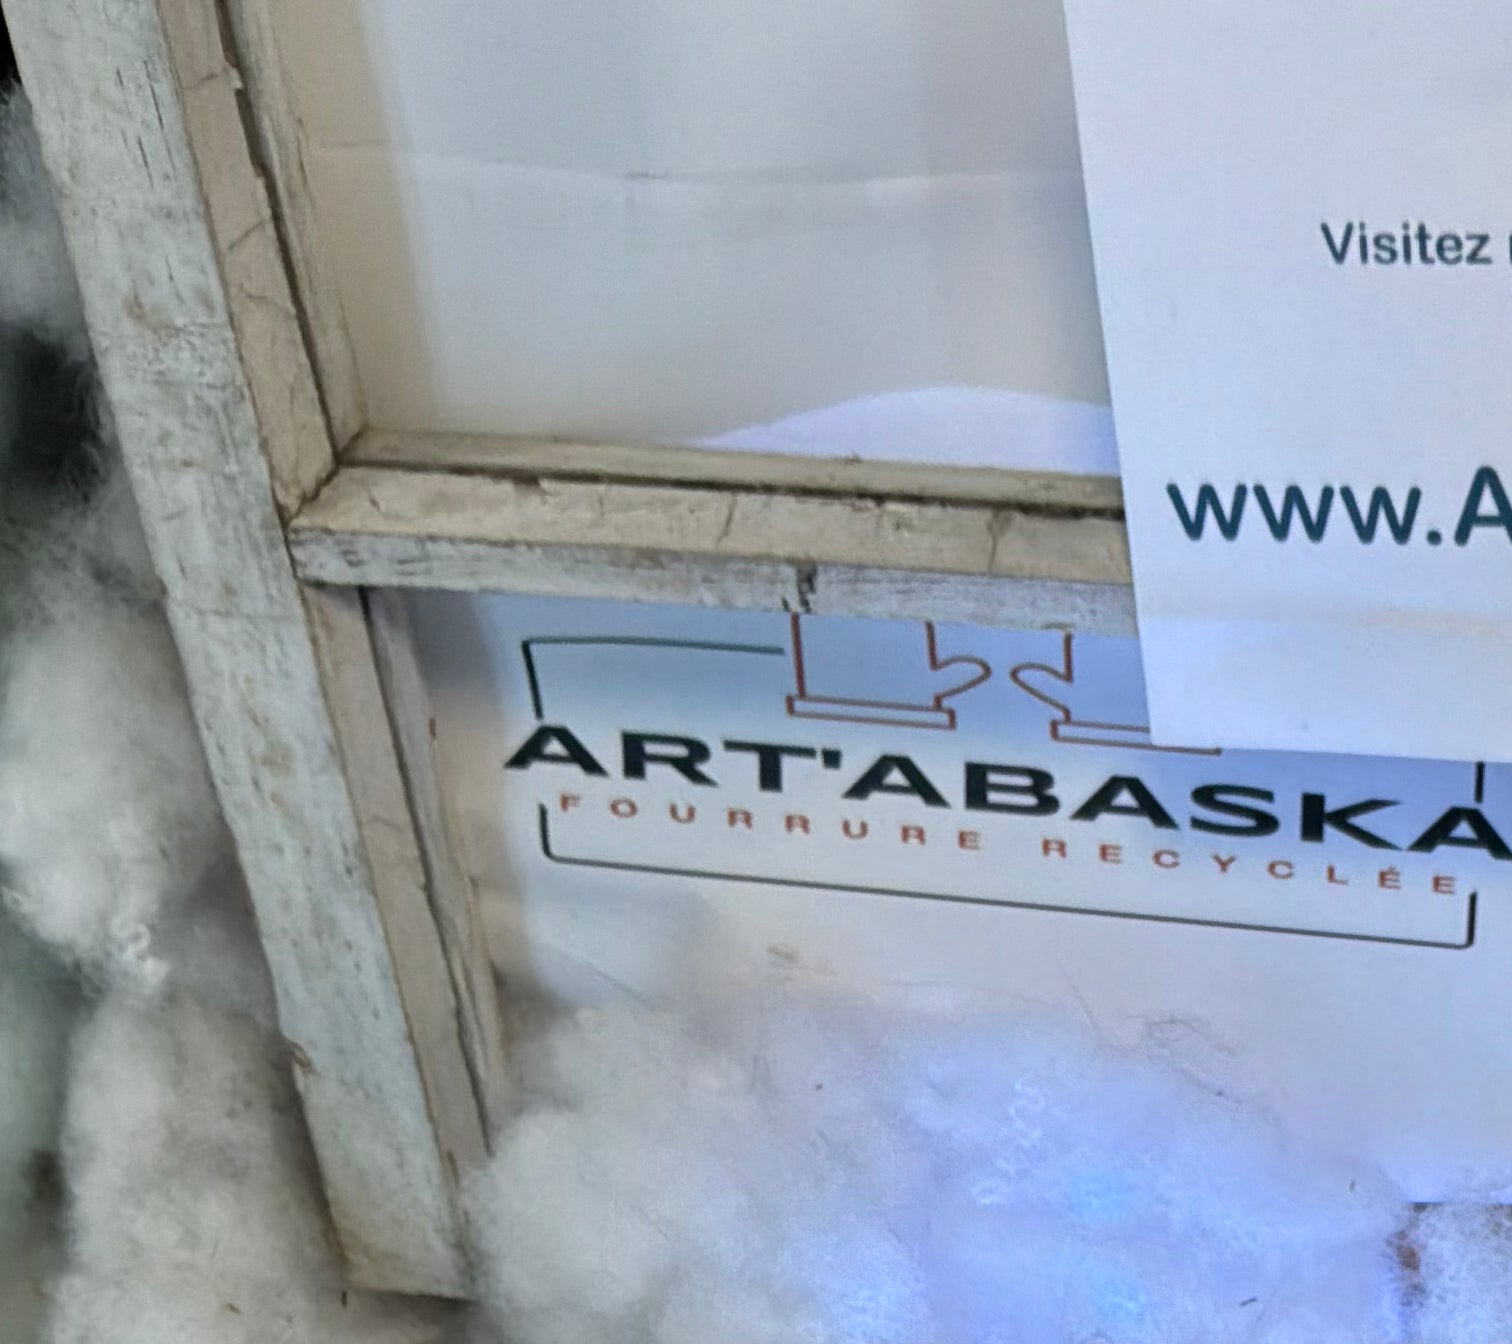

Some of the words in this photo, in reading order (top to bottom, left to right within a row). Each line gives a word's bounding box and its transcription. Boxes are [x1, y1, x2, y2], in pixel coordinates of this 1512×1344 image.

[1320, 220, 1492, 267] Visitez
[560, 794, 982, 850] FOURRURE
[1041, 839, 1457, 895] RECYCLÉE
